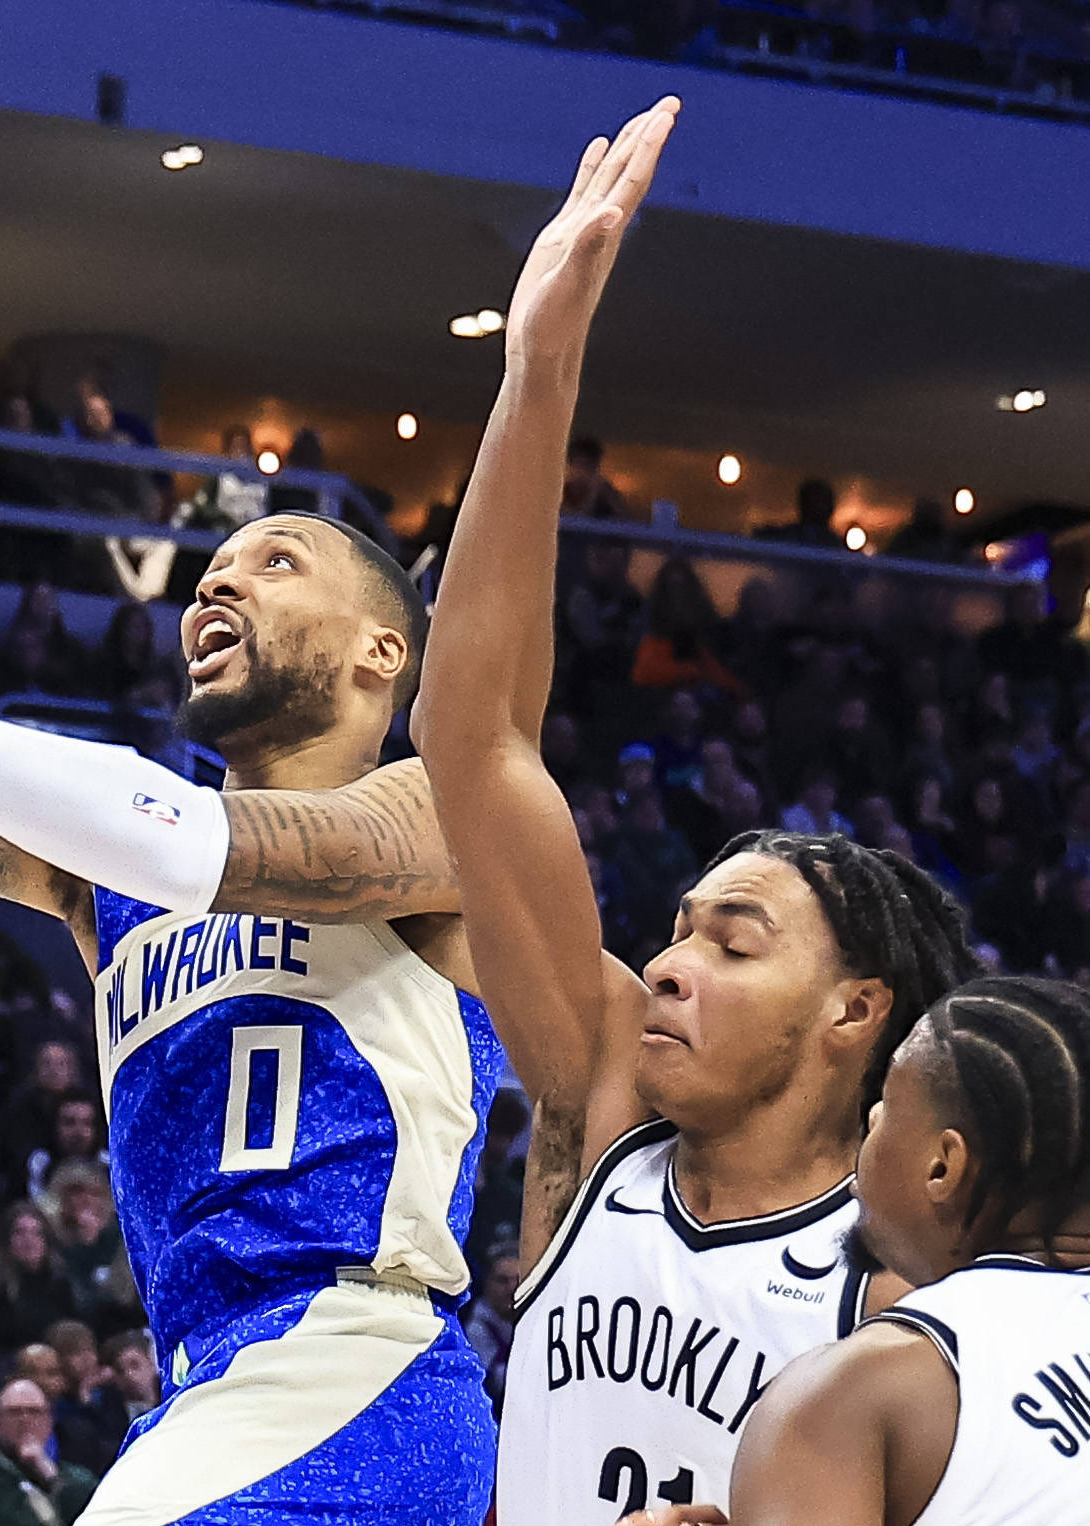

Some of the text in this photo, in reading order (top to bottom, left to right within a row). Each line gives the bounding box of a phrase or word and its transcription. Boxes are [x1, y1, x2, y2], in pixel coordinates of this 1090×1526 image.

[218, 1025, 303, 1172] 0
[767, 1279, 825, 1304] Webull
[547, 1295, 776, 1435] BROOKLY
